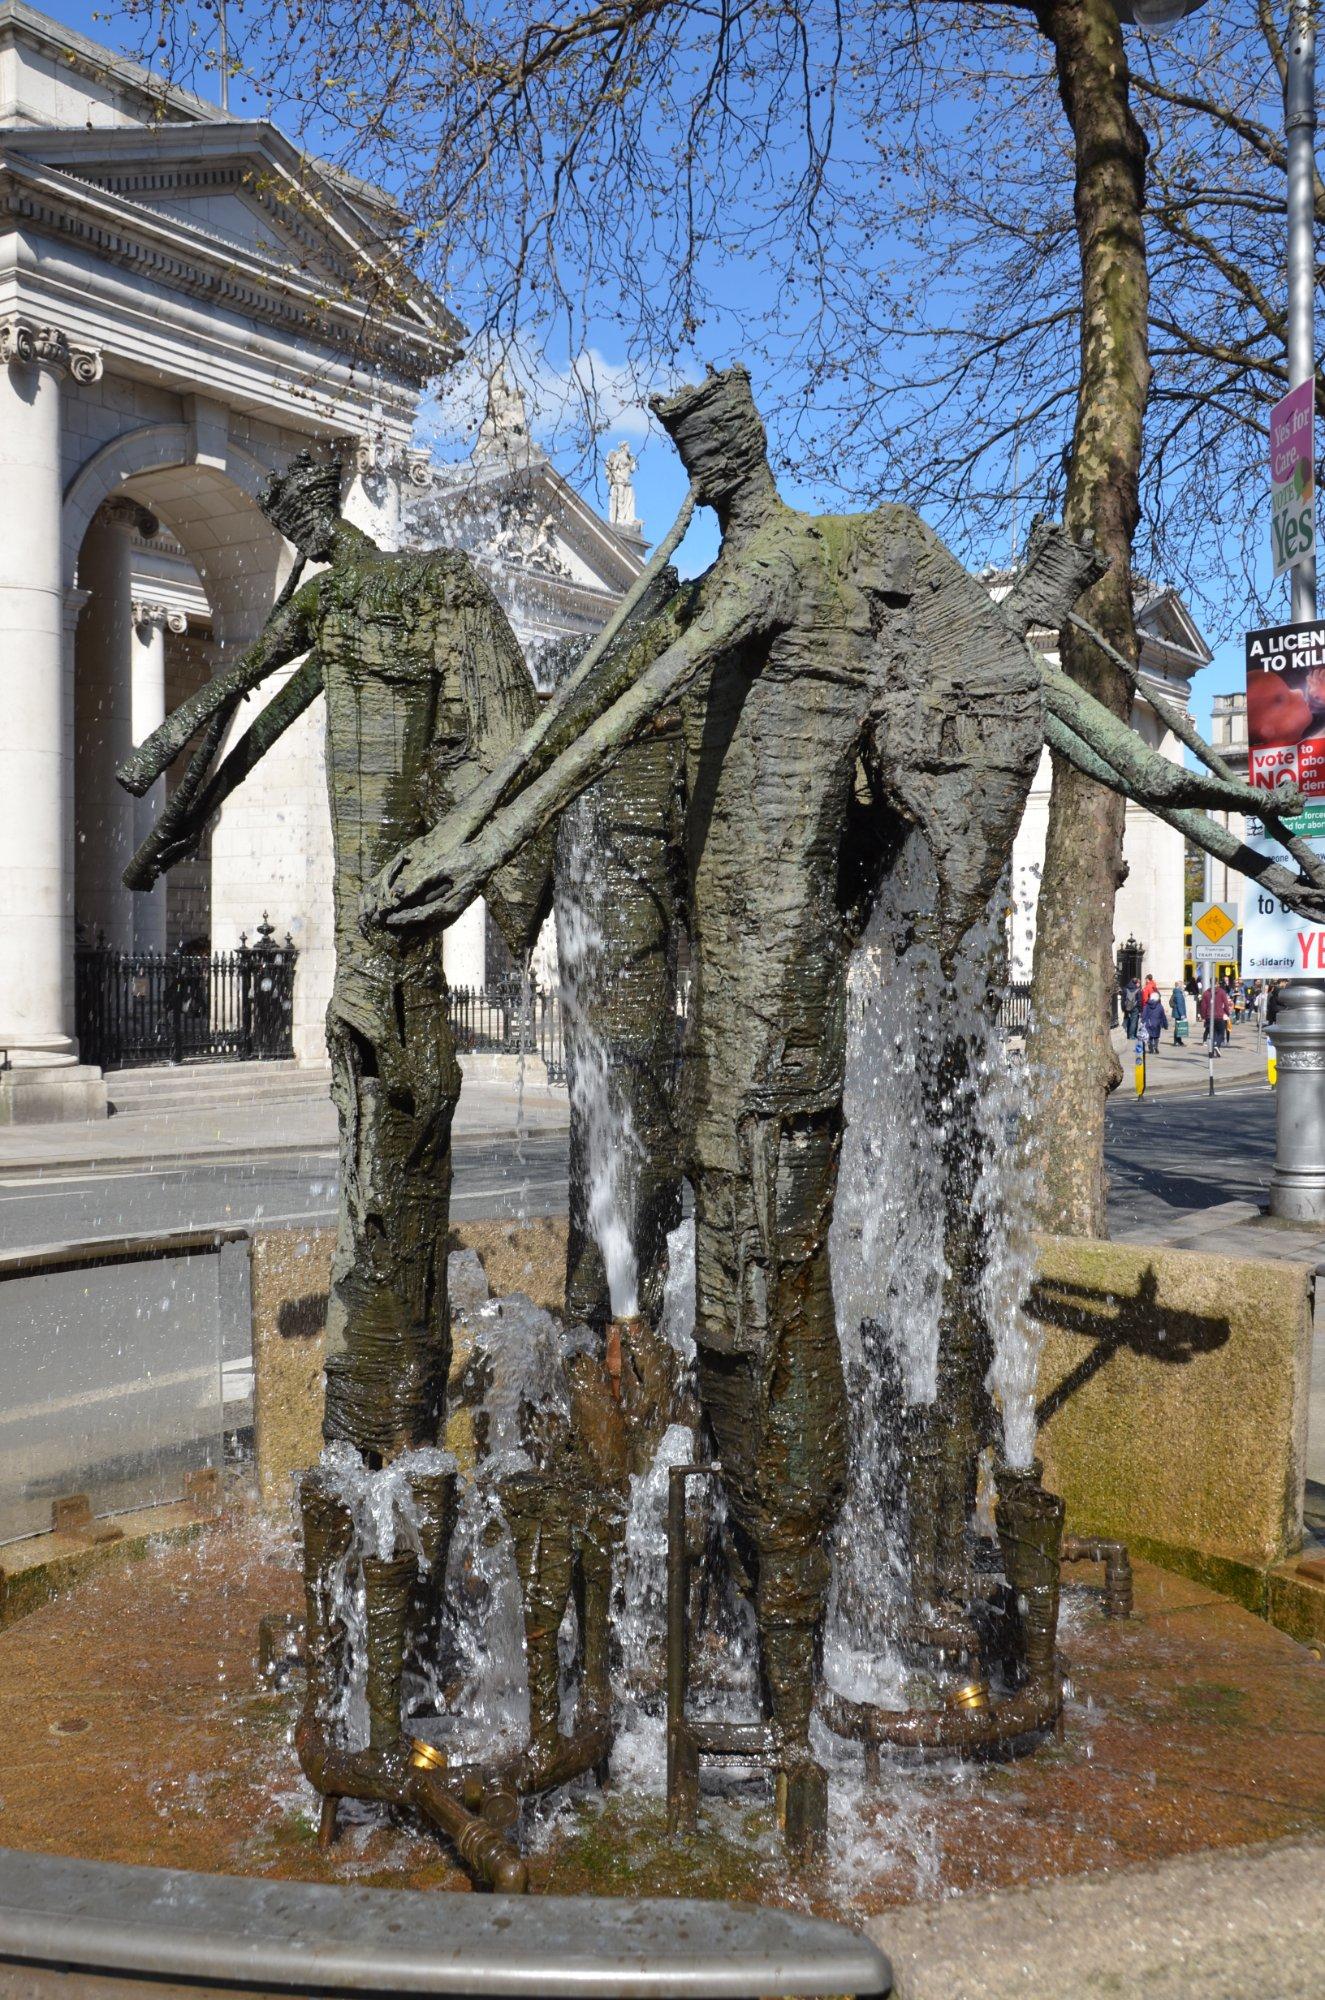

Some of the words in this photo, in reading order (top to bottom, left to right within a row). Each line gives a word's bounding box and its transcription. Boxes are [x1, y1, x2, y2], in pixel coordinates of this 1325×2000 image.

[1274, 423, 1290, 447] Yes
[1293, 407, 1310, 434] for
[1275, 446, 1299, 475] Care.
[1272, 482, 1294, 513] VOTE
[1273, 508, 1313, 567] Yes
[1250, 640, 1264, 657] A
[1269, 630, 1325, 653] LICEN
[1260, 655, 1286, 673] TO
[1255, 751, 1295, 767] vote
[1301, 745, 1313, 754] to
[1256, 769, 1297, 790] NO
[1302, 770, 1317, 778] on
[1304, 811, 1325, 819] force
[1258, 895, 1274, 915] to
